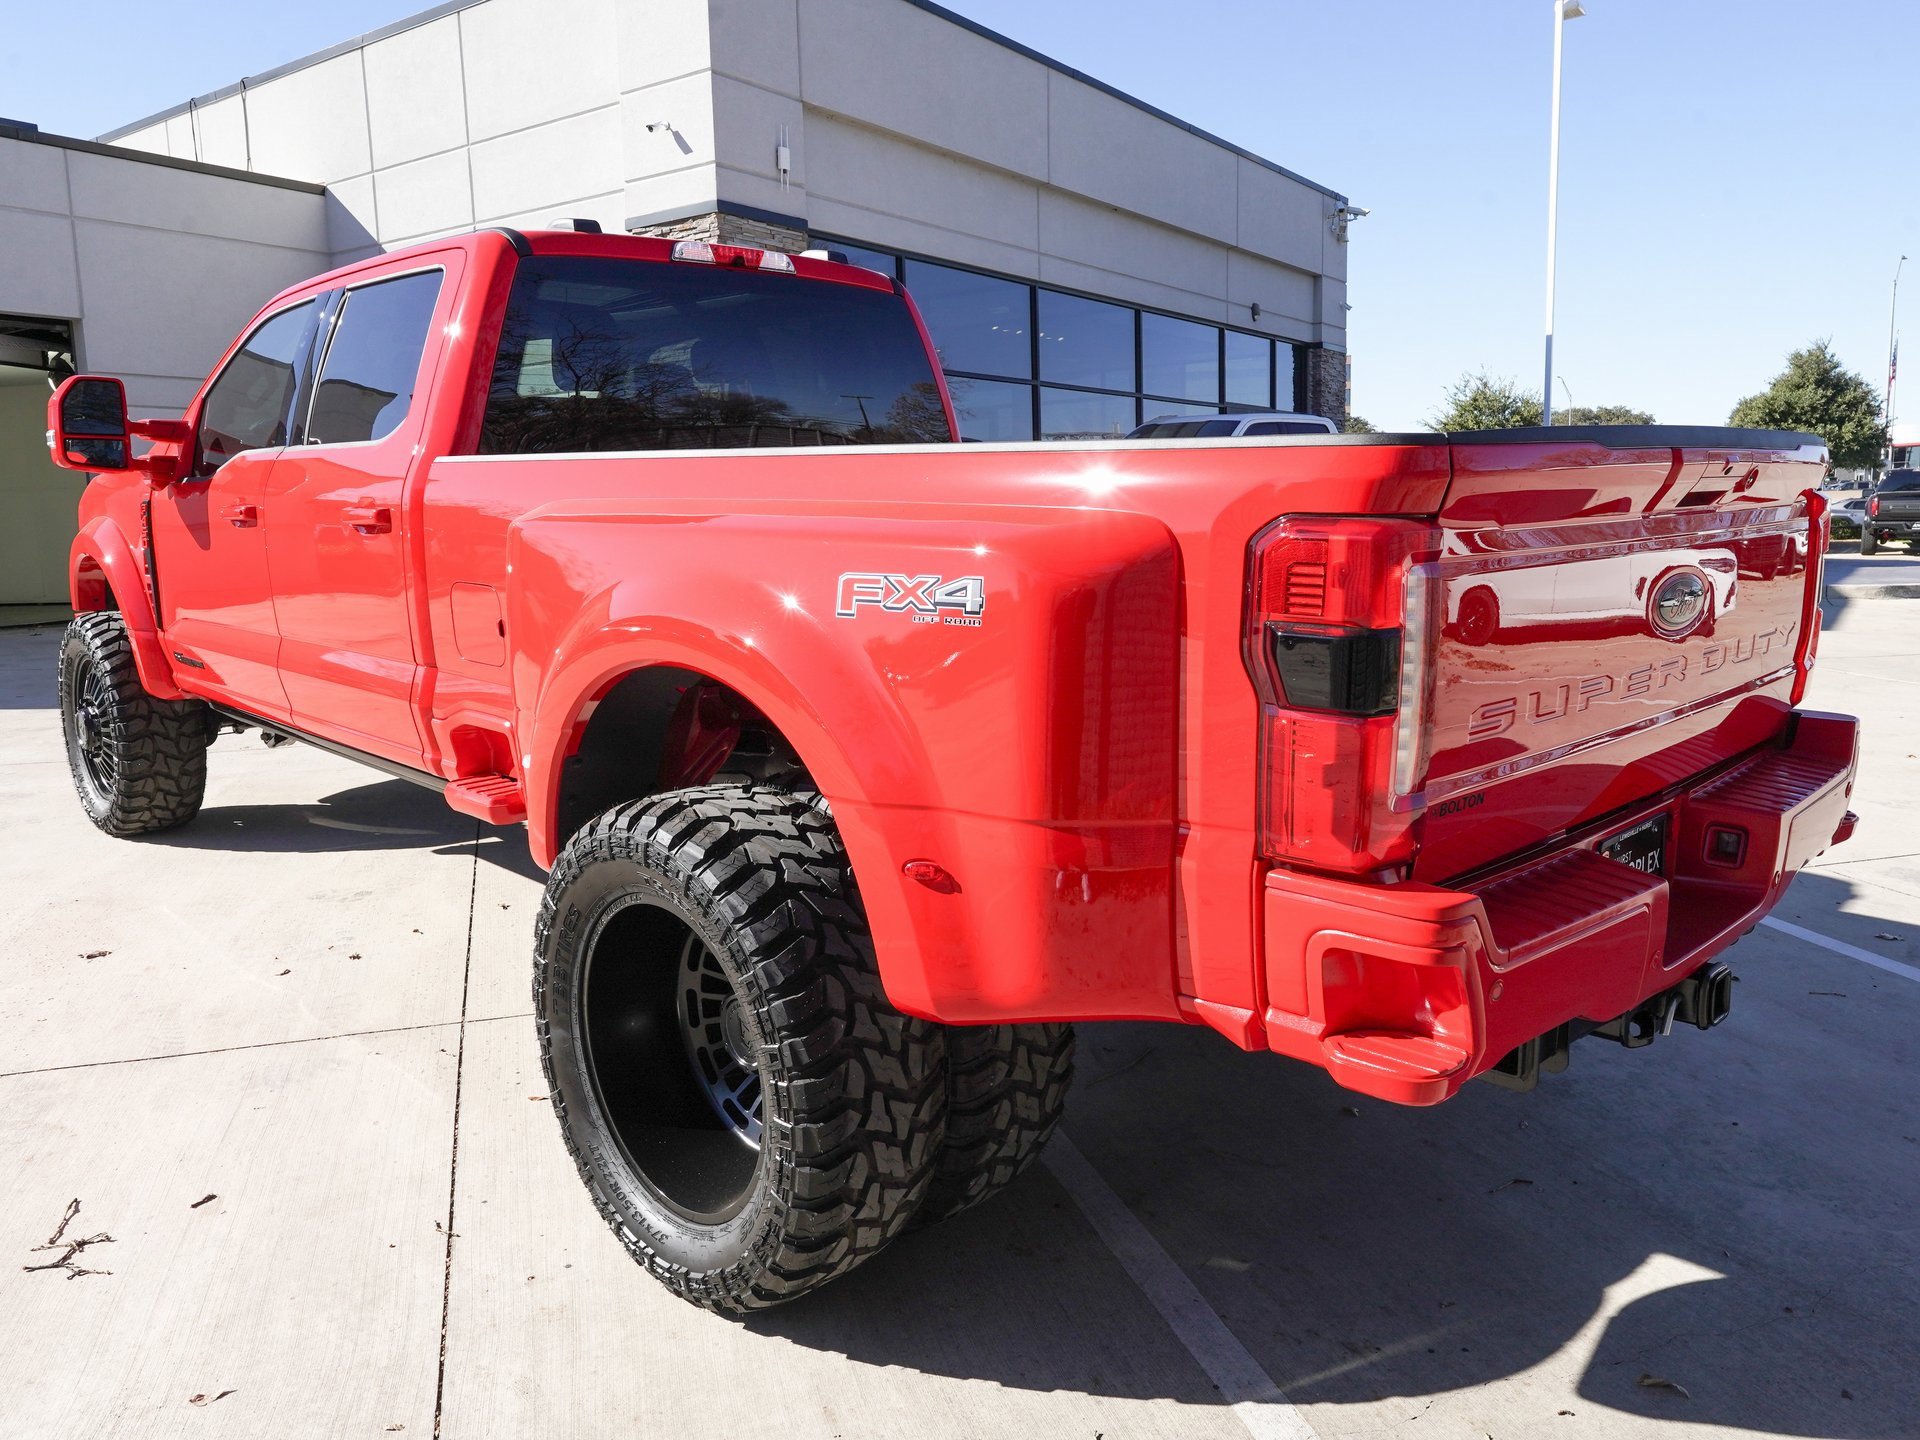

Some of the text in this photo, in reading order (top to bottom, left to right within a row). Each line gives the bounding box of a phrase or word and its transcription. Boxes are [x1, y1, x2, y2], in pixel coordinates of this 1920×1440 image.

[836, 572, 985, 618] FX4
[912, 615, 982, 627] OFF ROAD
[1468, 622, 1796, 743] SUPER DUTY
[1439, 791, 1486, 818] BOLTON
